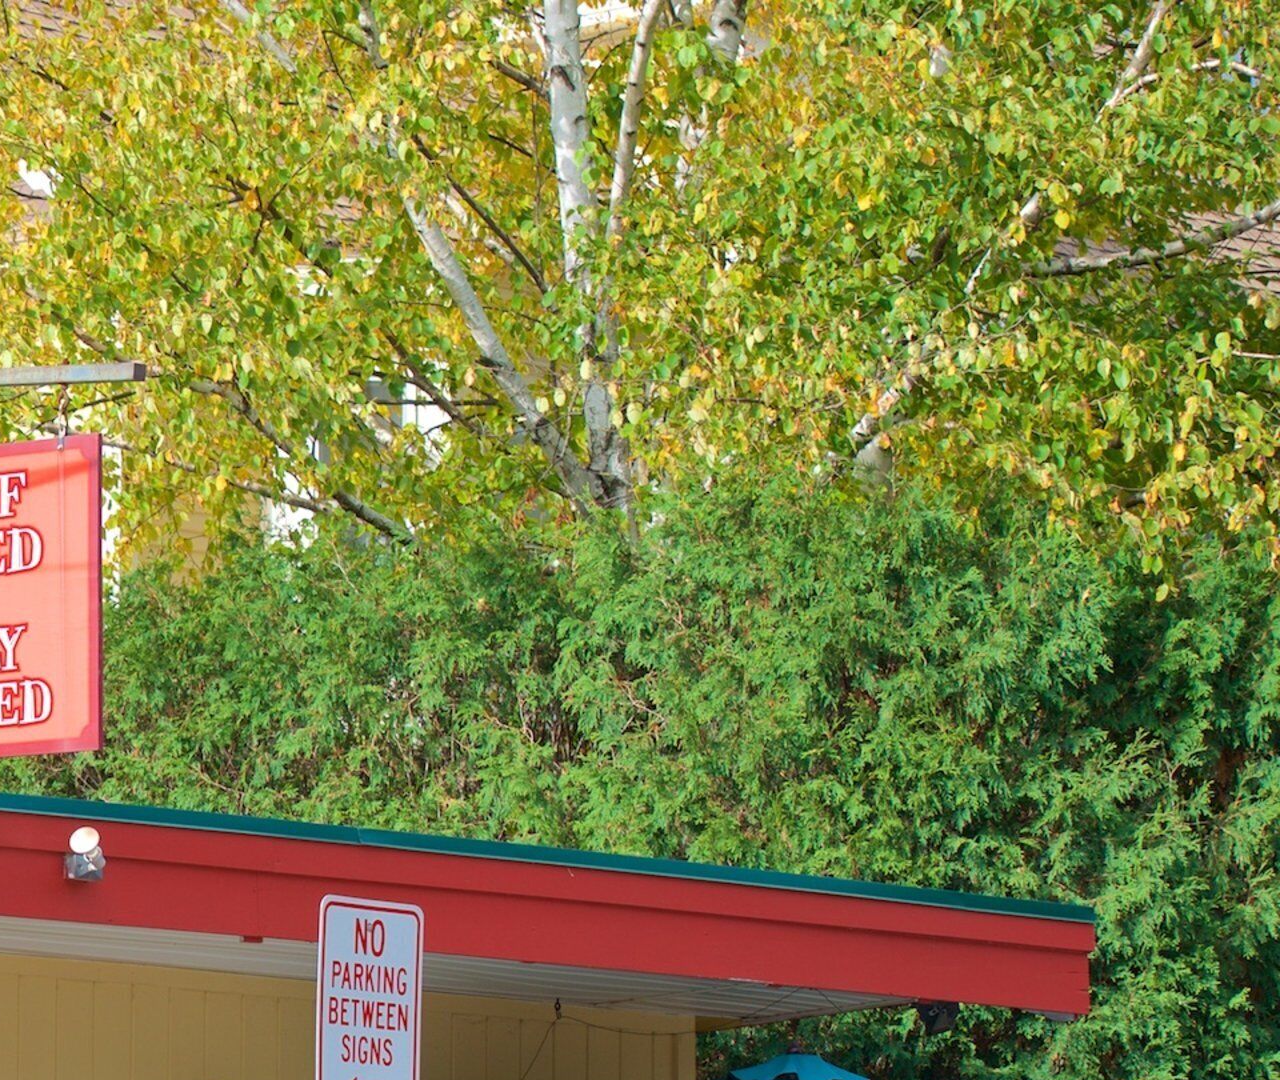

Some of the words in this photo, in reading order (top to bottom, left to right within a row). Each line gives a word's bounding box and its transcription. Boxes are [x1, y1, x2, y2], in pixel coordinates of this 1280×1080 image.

[354, 918, 386, 958] NO
[331, 961, 408, 996] PARKING
[328, 997, 409, 1032] BETWEEN
[341, 1034, 393, 1067] SIGNS
